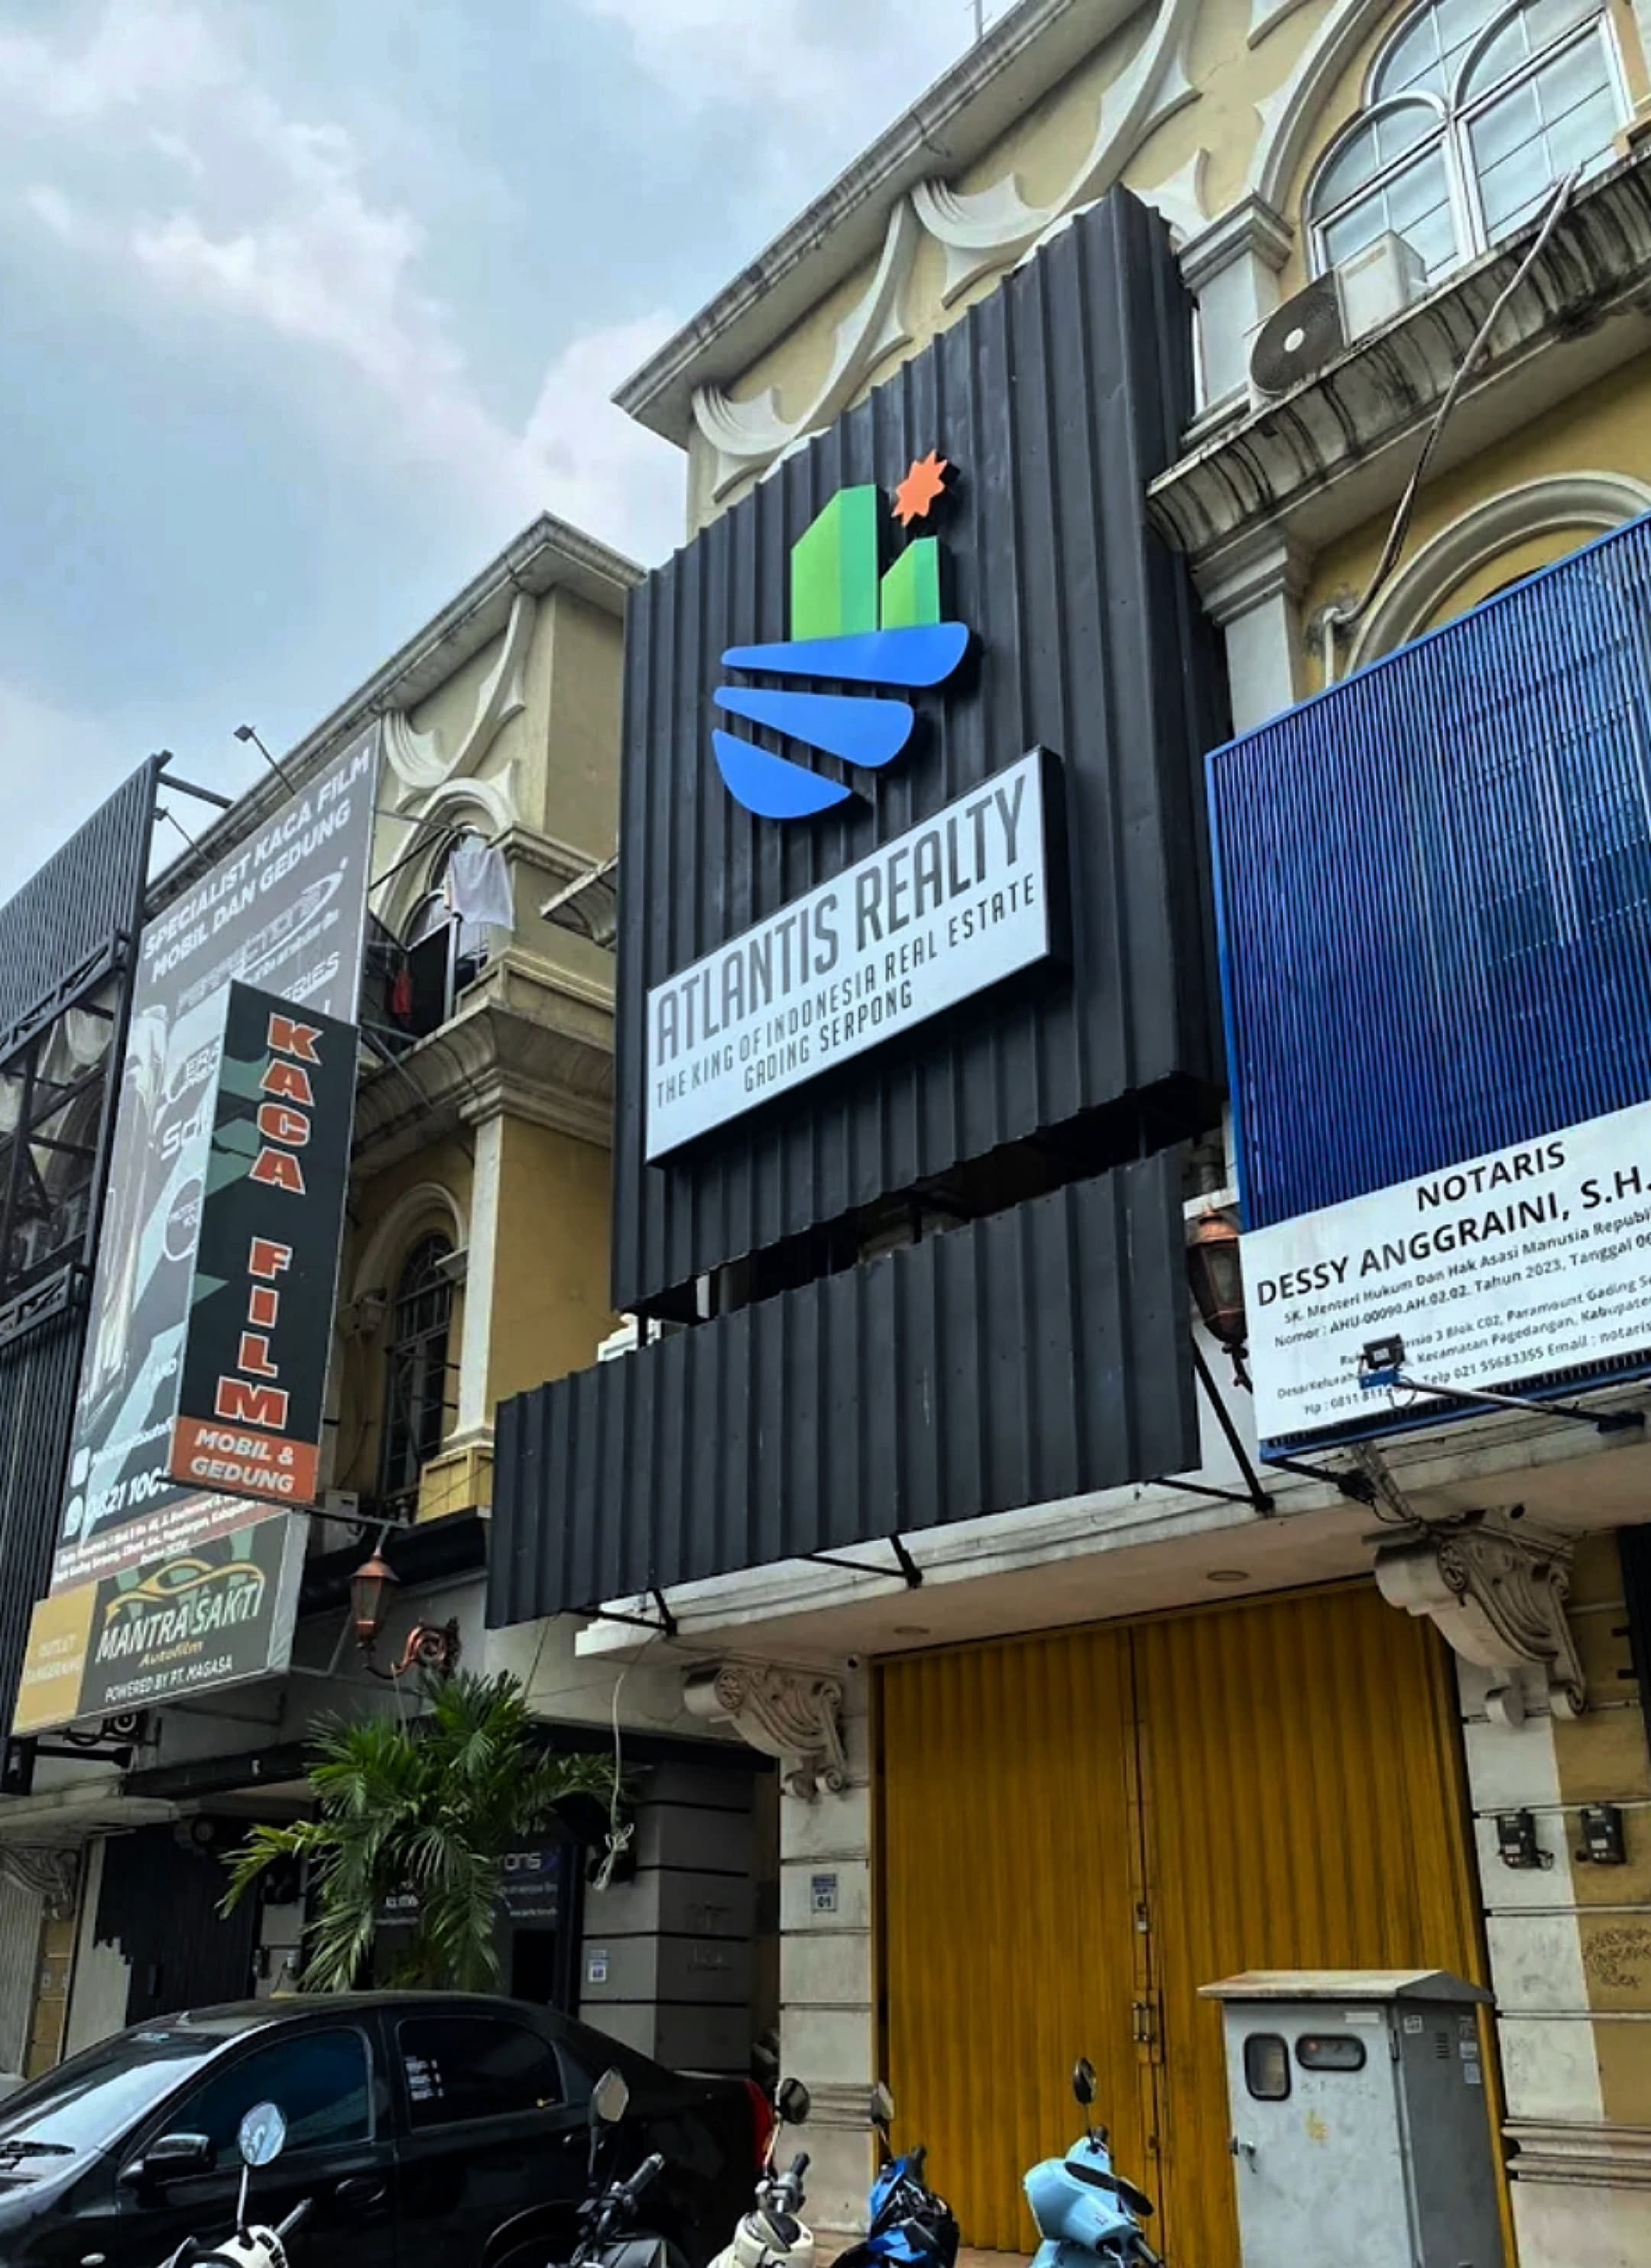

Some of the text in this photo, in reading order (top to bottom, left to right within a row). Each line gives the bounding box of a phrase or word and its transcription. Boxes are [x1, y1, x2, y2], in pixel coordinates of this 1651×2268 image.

[143, 853, 252, 961] SPECIALIST
[253, 801, 311, 867] KACA
[317, 746, 370, 812] FILM
[151, 921, 210, 984] MOBIL
[212, 877, 257, 936] DAN
[259, 799, 352, 894] GEDUNG
[656, 773, 1026, 1068] ATLANTIS REALTY
[657, 872, 1036, 1109] THE KING OF INDONESIA REAL ESTATE
[744, 979, 914, 1094] GADING SERPONG
[249, 1012, 323, 1195] KACA
[1416, 1140, 1565, 1213] NOTARIS
[1256, 1253, 1350, 1307] DESSY
[1359, 1190, 1571, 1278] ANGGRAINI,
[1273, 1327, 1320, 1349] Nomor
[1474, 1270, 1523, 1294] Tahun
[1568, 1236, 1633, 1265] Tanggal
[1307, 1291, 1360, 1320] Menteri
[1362, 1278, 1413, 1301] Hukum
[1416, 1268, 1445, 1287] Dan
[1447, 1258, 1478, 1278] Hak
[1480, 1244, 1520, 1268] Asasi
[1522, 1227, 1590, 1256] Manusia
[1506, 1292, 1585, 1323] Paramount
[1585, 1278, 1637, 1301] Gading
[215, 1237, 290, 1430] FILM
[1580, 1297, 1651, 1323] Kabupate
[190, 1455, 295, 1494] GEDUNG
[194, 1427, 271, 1463] MOBIL
[276, 1446, 294, 1466] &
